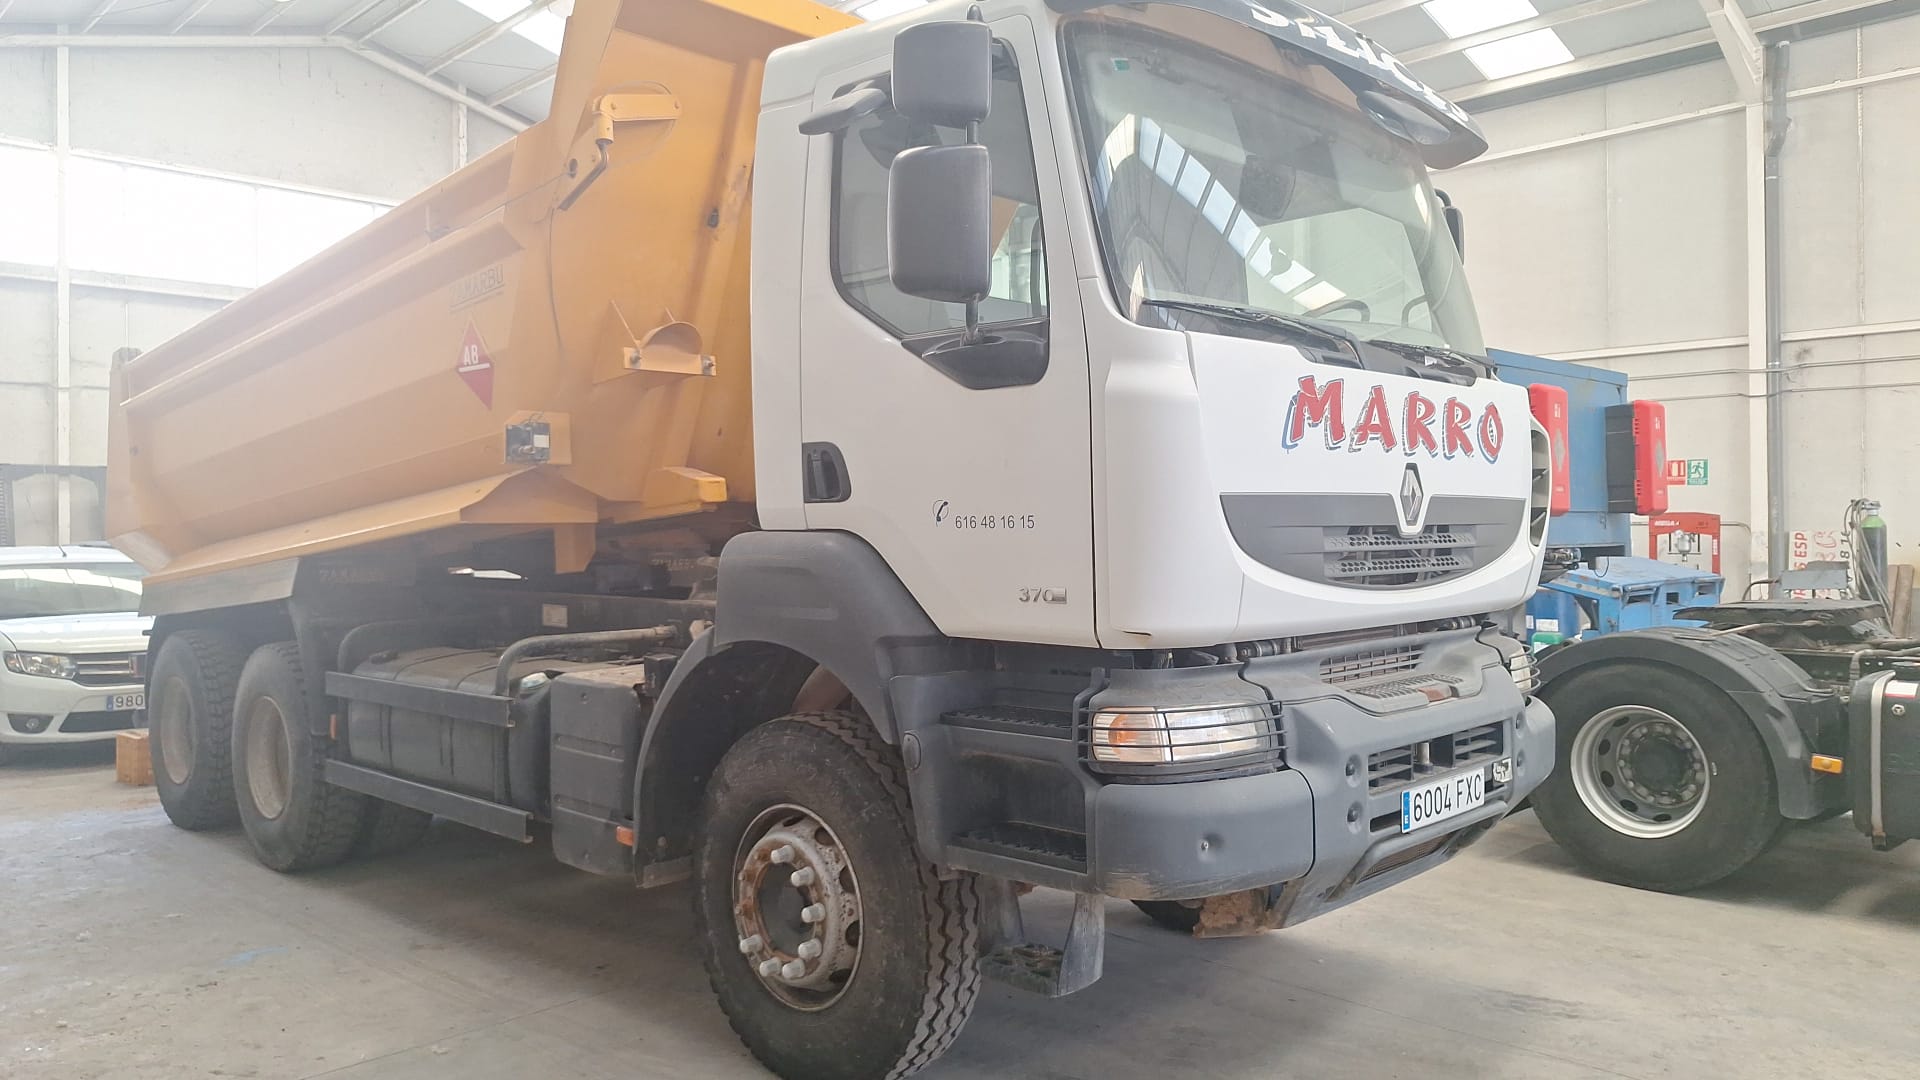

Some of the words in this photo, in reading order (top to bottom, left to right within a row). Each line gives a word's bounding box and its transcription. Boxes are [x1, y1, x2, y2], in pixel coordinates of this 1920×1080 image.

[464, 344, 479, 366] AB
[1281, 374, 1504, 464] MARRO
[955, 515, 977, 529] 616
[980, 515, 996, 529] 48
[1000, 515, 1015, 529] 16
[1020, 514, 1035, 529] 15
[1018, 587, 1055, 603] 370
[115, 694, 144, 708] 980
[1413, 783, 1452, 822] 6004
[1456, 773, 1482, 809] FXC
